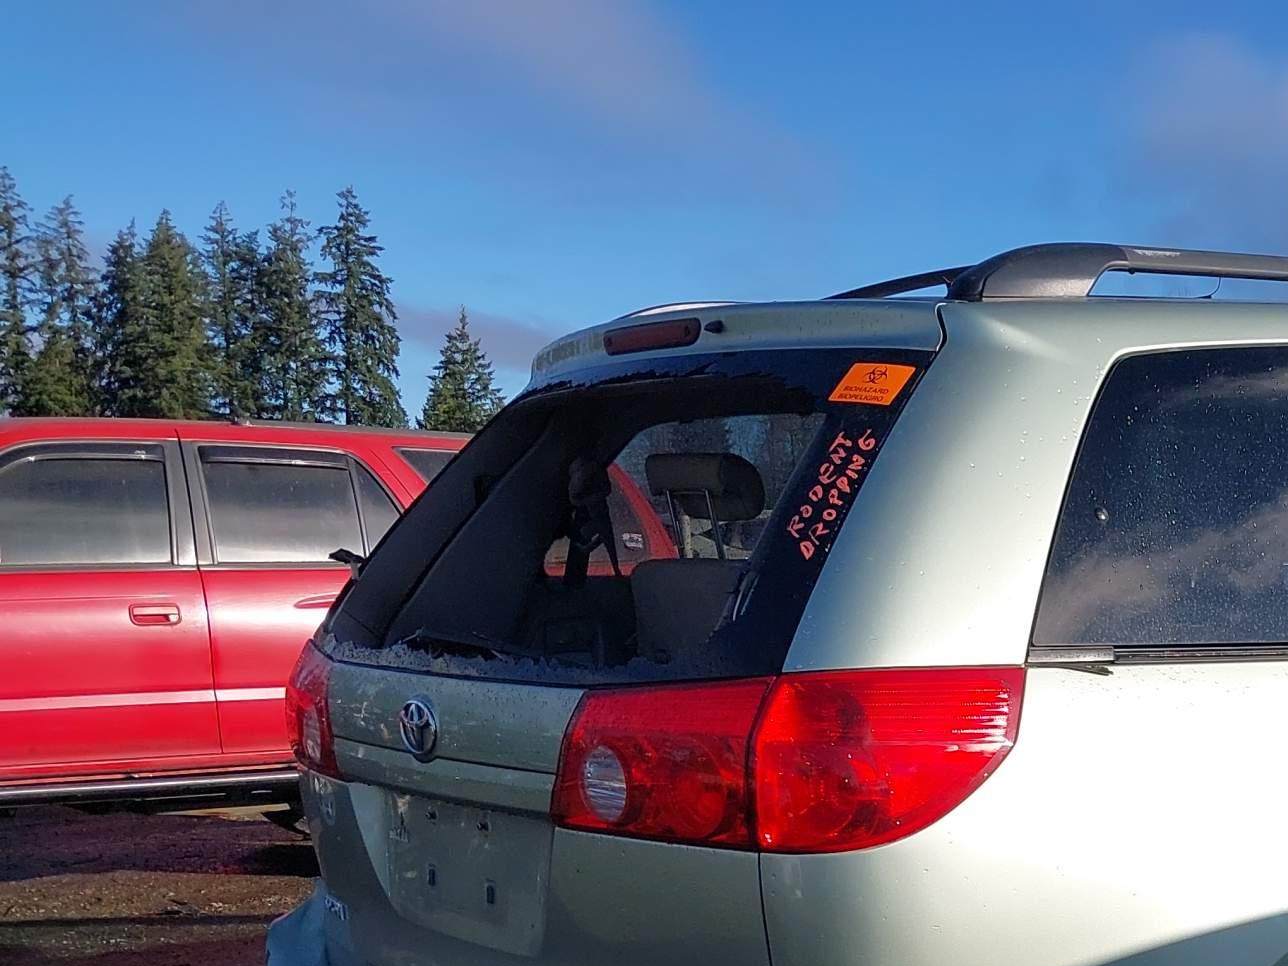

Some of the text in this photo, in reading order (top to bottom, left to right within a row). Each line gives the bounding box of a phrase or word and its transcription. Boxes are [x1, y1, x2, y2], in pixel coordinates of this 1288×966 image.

[842, 384, 890, 395] BIOHAZARD
[786, 431, 853, 539] RODENT
[799, 428, 876, 560] DROPPING
